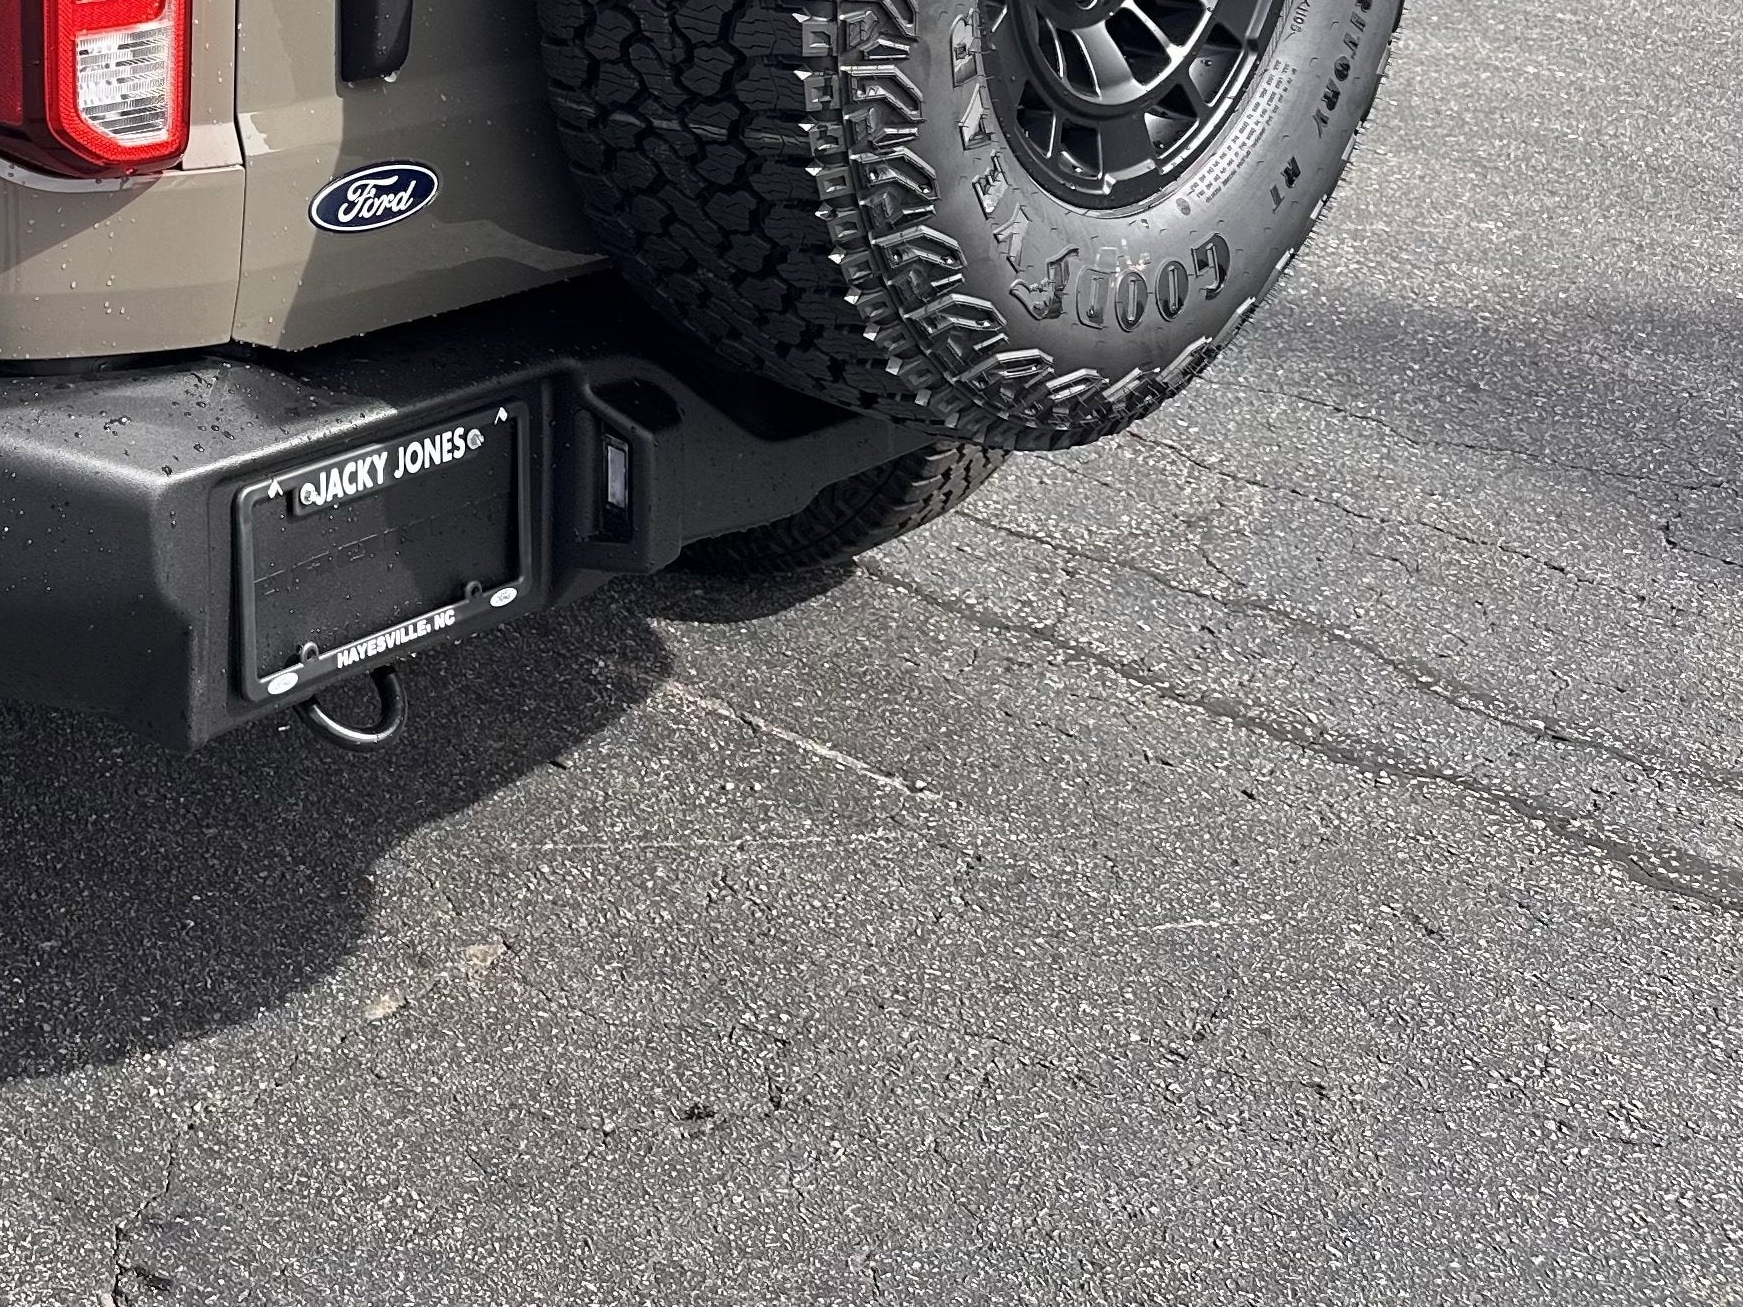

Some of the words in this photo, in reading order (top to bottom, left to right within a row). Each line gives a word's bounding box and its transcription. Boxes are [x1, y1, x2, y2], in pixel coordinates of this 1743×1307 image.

[337, 175, 417, 223] Ford
[950, 8, 1231, 333] GOODYEAR
[314, 451, 388, 506] JACKY
[393, 426, 467, 480] JONES
[336, 620, 432, 669] HAYESVILLE,
[433, 608, 456, 631] NC
